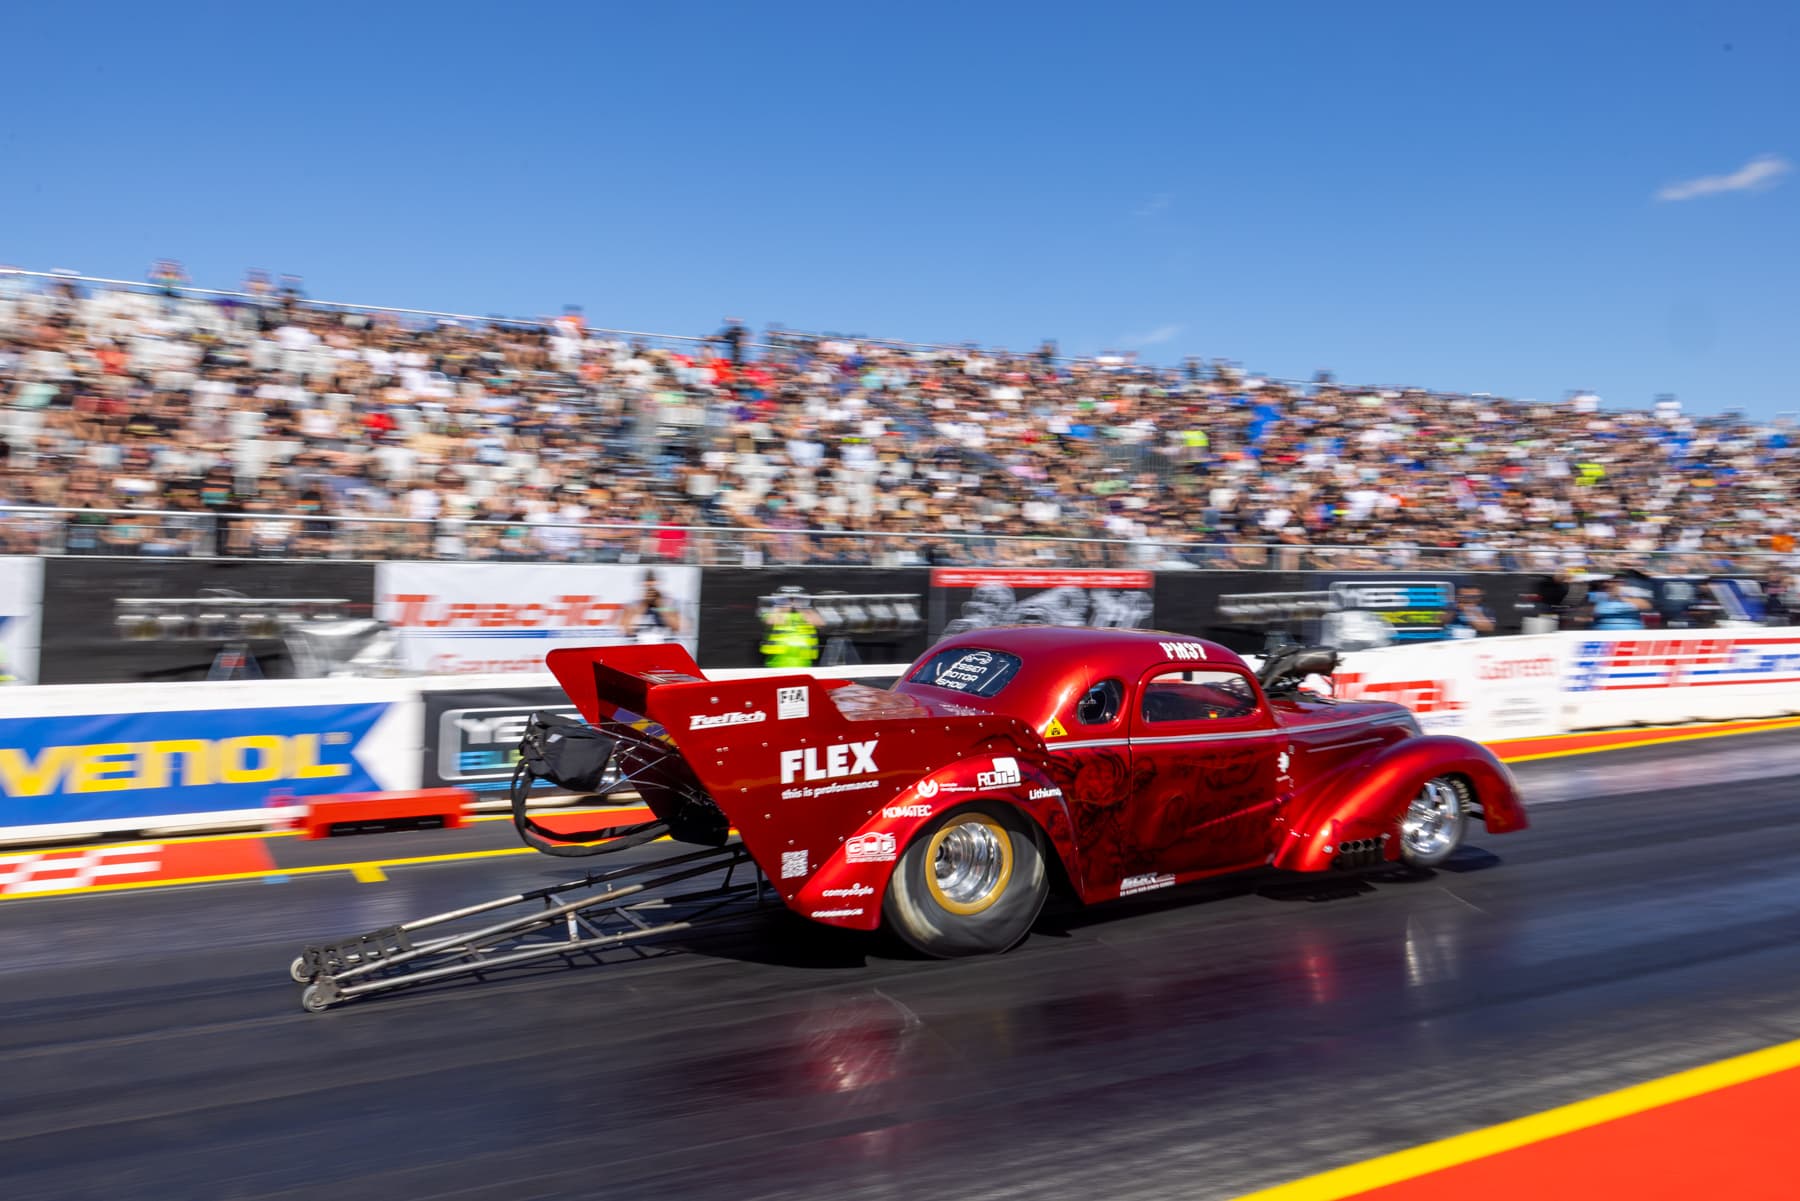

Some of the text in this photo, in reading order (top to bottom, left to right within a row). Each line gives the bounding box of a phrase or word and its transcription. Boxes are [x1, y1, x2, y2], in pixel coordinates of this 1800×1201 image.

[1158, 641, 1208, 660] PM37
[780, 688, 805, 704] FIA
[689, 710, 767, 728] FuelTech
[780, 740, 879, 784] FLEX
